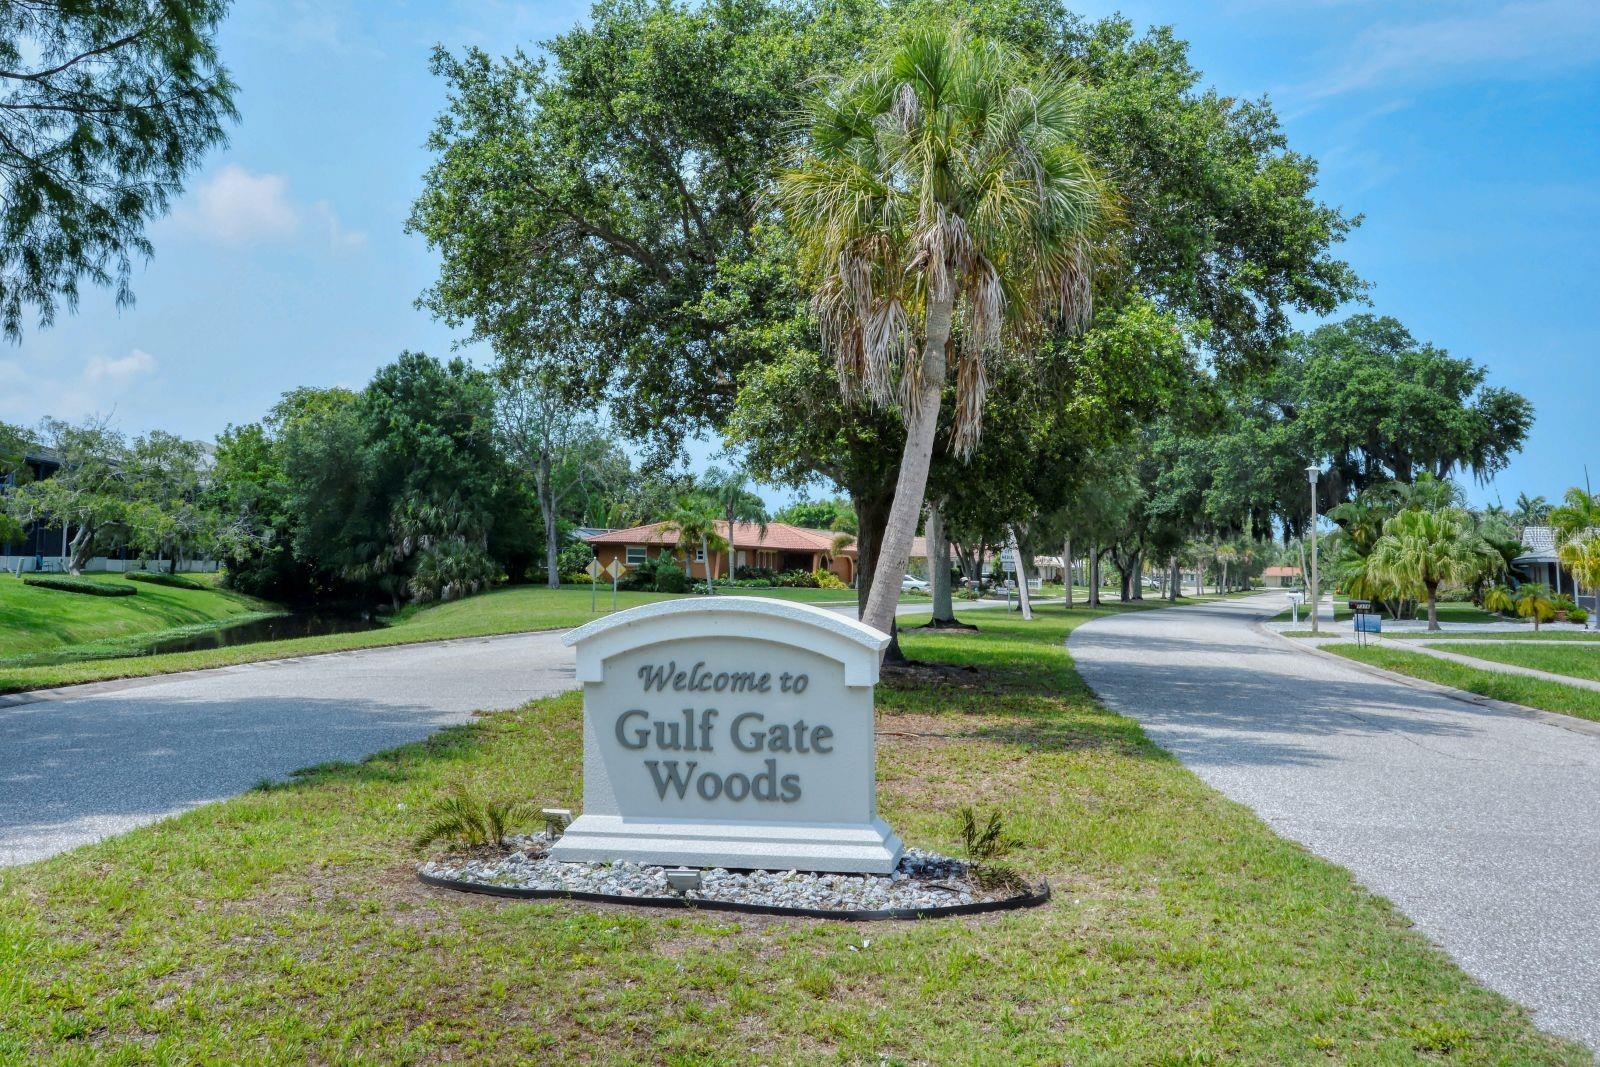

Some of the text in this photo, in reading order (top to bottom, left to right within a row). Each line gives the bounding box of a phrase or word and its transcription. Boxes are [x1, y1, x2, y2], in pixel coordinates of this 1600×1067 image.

[637, 660, 809, 694] Welcome to
[614, 708, 834, 753] Gulf Gate
[644, 758, 802, 803] Woods
